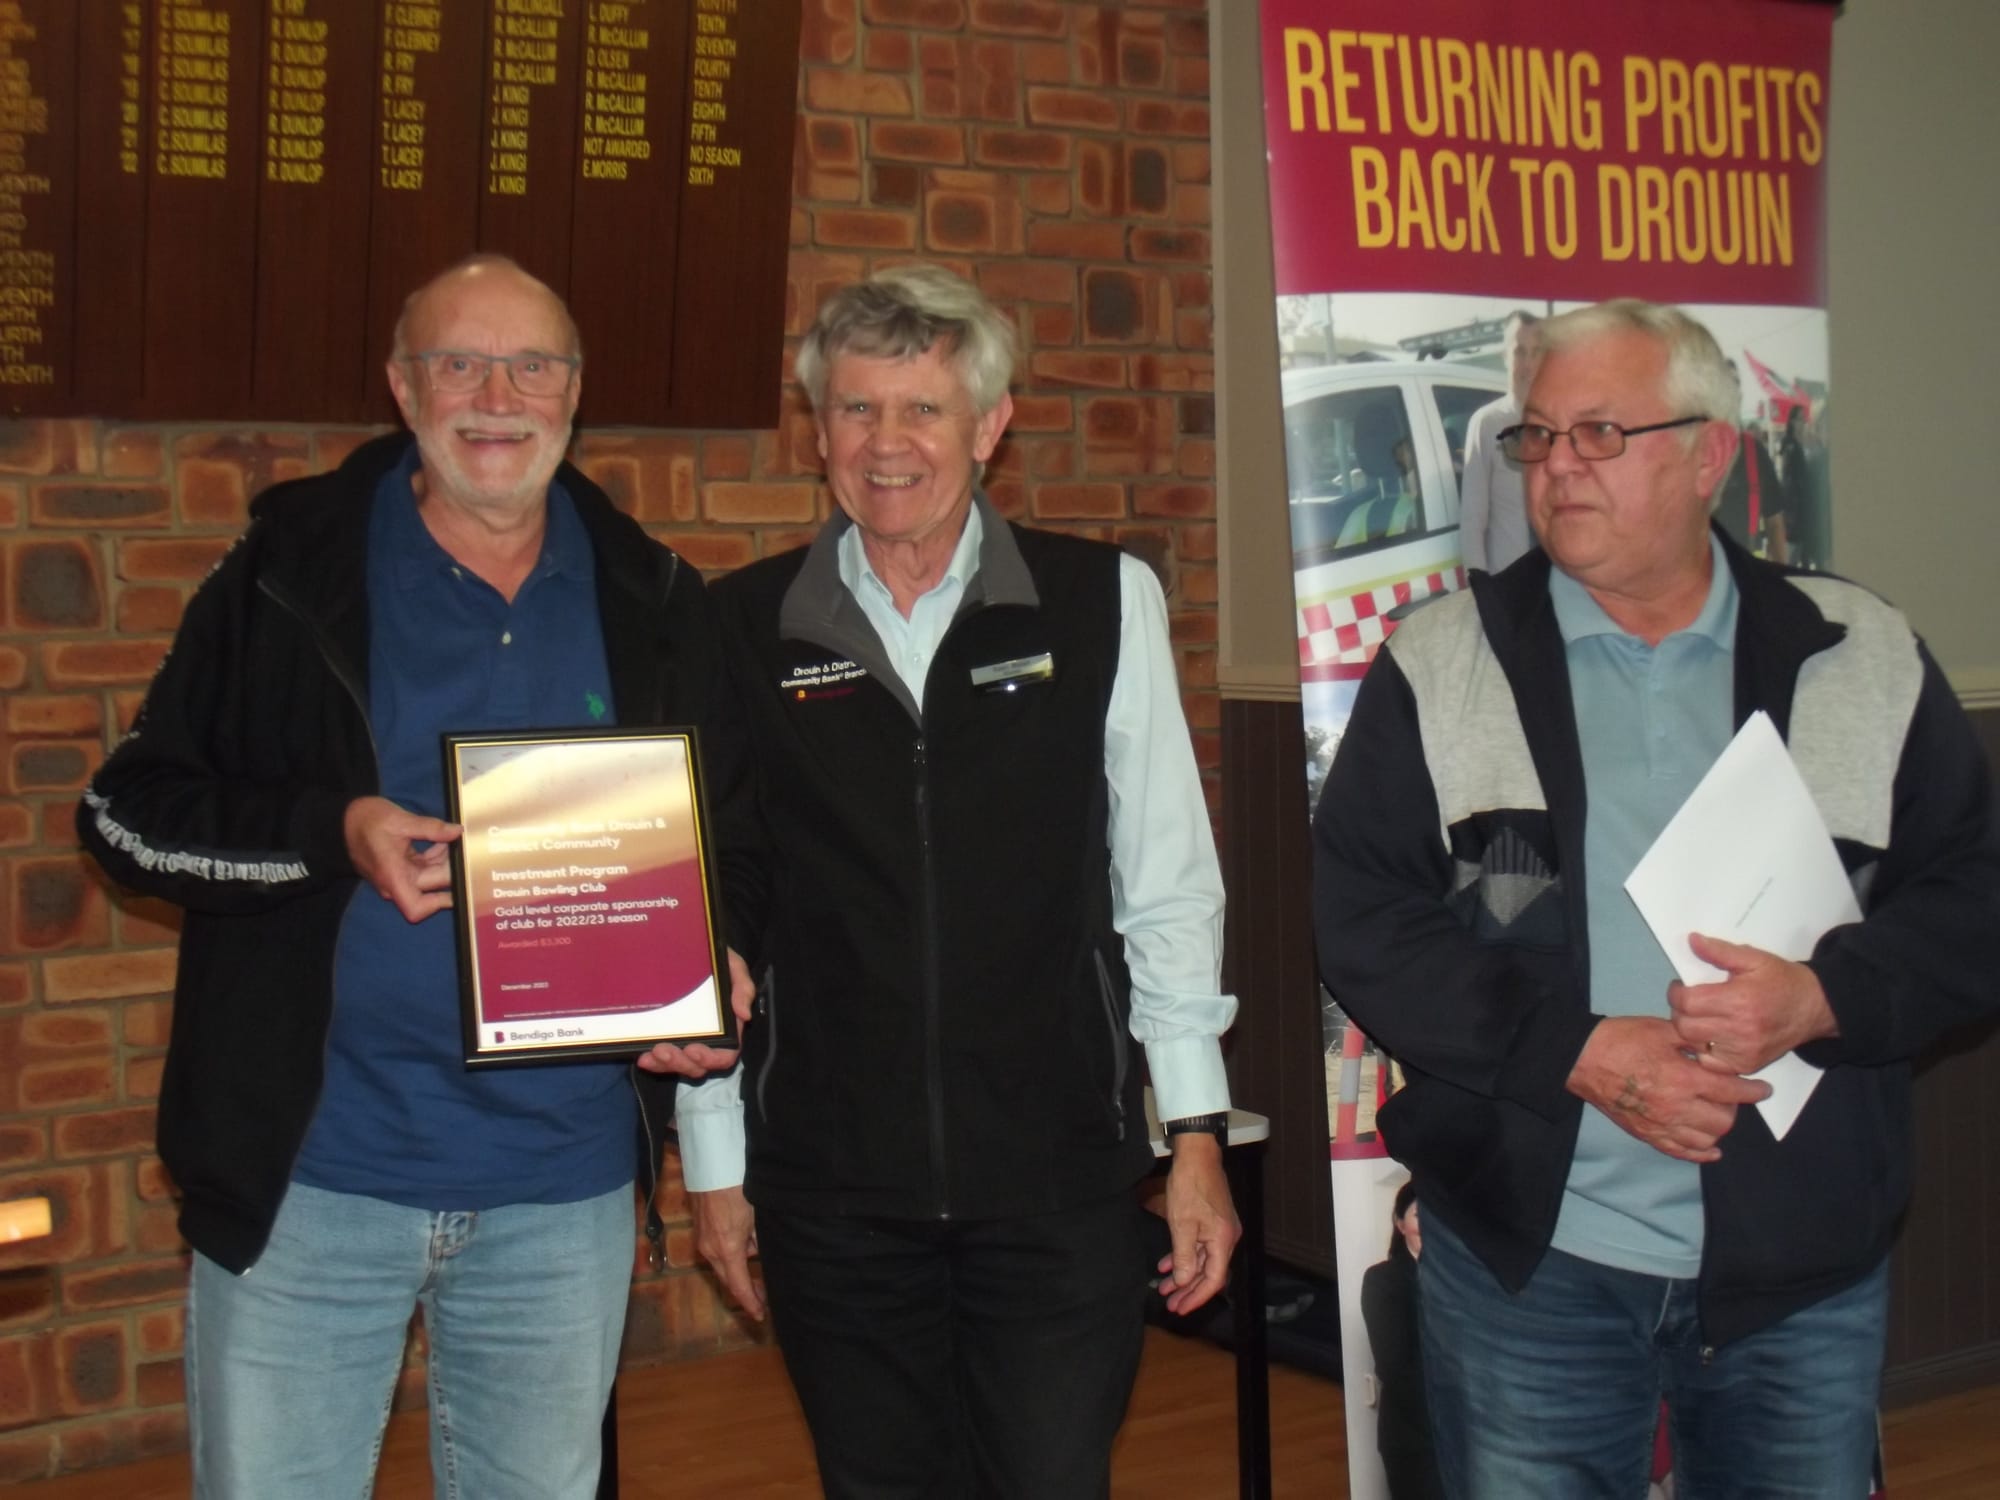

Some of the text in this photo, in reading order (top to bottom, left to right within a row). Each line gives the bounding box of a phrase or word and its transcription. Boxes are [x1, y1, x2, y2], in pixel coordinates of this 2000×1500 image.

[698, 13, 727, 34] TENTH
[599, 26, 649, 50] McCALLUM
[696, 36, 737, 57] SEVENTH
[695, 58, 731, 79] FOURTH
[597, 71, 646, 92] McCALLUM
[694, 79, 723, 100] TENTH
[596, 93, 645, 114] McCALLUM
[1284, 28, 1822, 165] RETURNING PROFITS
[692, 100, 727, 121] EIGHTH
[595, 116, 644, 136] McCALLUM
[691, 122, 716, 143] FIFTH
[583, 136, 651, 160] NOT AWARDED
[690, 143, 741, 167] NO SEASON
[688, 165, 714, 185] SIXTH
[1351, 146, 1793, 267] BACK TO DROUIN
[822, 664, 830, 673] &
[608, 818, 653, 831] Drouin
[655, 817, 667, 829] &
[541, 836, 621, 850] Community
[491, 864, 628, 881] Investment Program
[493, 881, 607, 898] Drouin Bowling Club
[495, 897, 679, 917] Gold level corporate sponsorship
[496, 913, 648, 930] of club for 2022/23 season
[498, 939, 538, 949] Awarded
[510, 1031, 554, 1043] Bendigo
[557, 1028, 584, 1038] Bank
